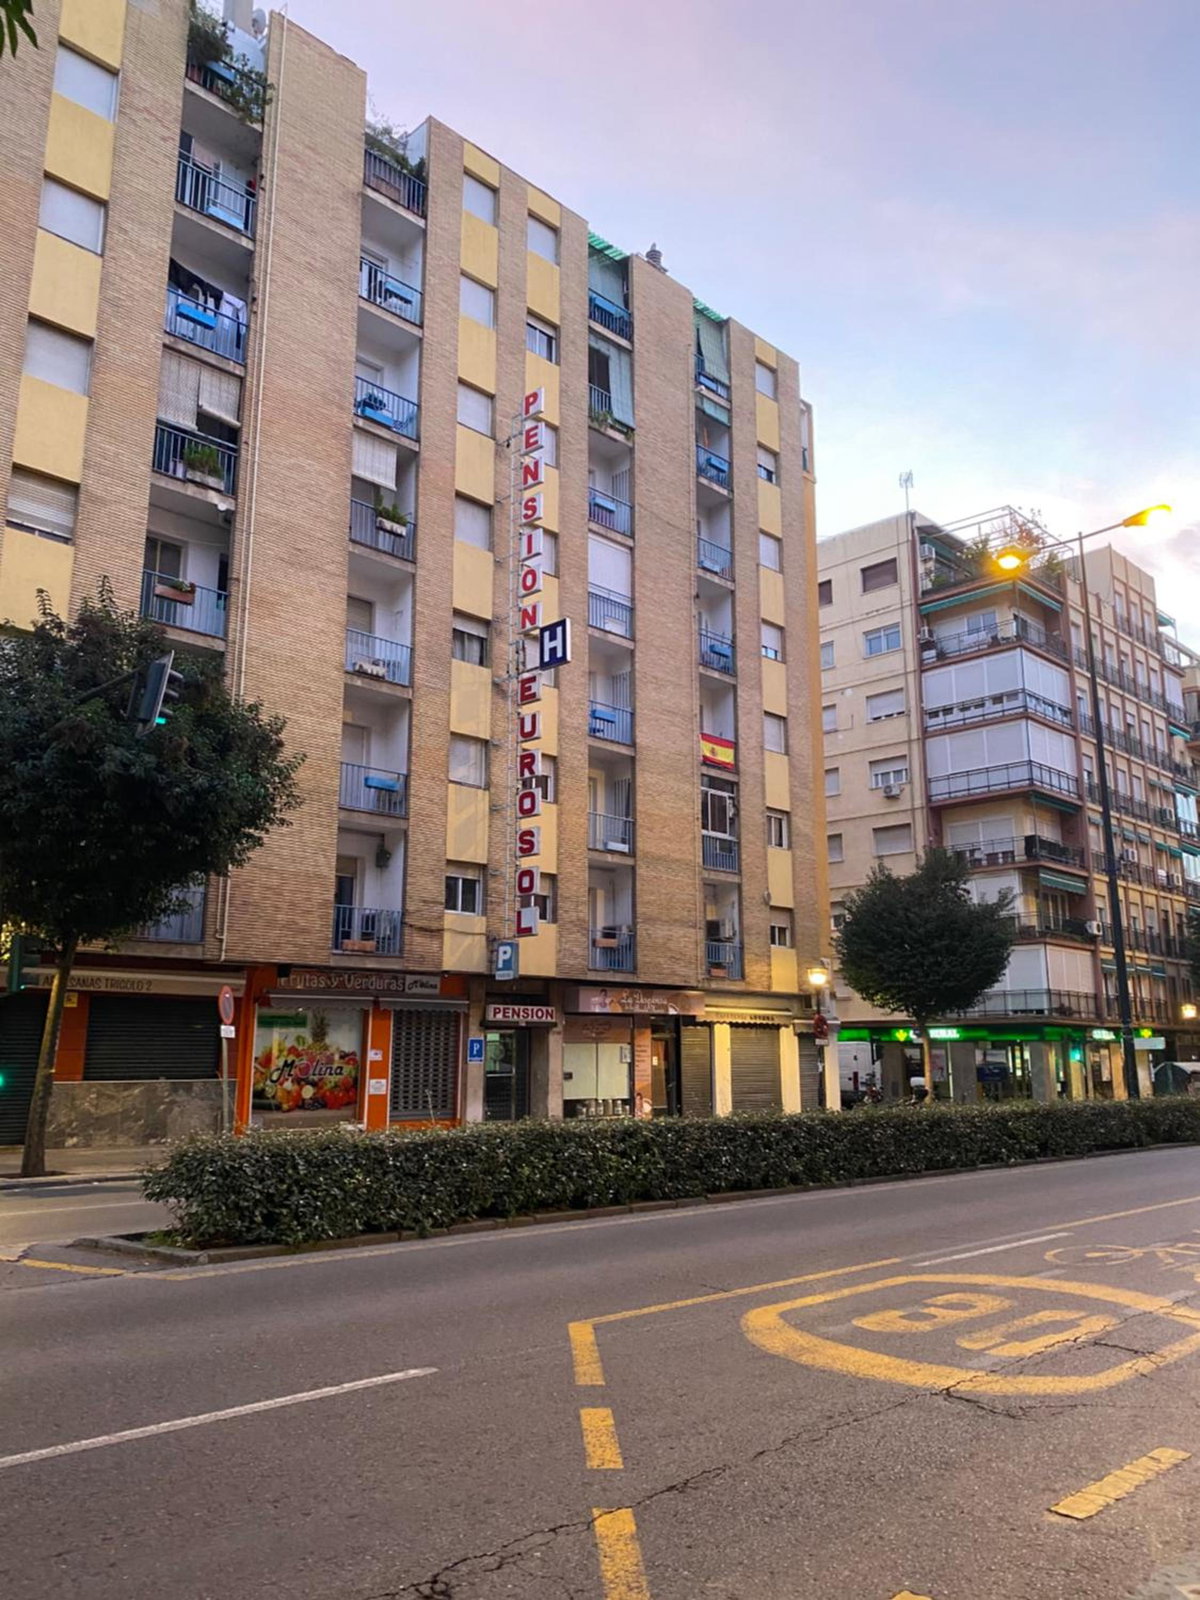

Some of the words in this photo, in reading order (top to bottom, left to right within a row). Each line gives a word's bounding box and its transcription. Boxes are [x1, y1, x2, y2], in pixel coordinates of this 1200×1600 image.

[521, 391, 539, 629] PENSION
[543, 625, 563, 662] H
[516, 675, 537, 934] EUROSOL
[497, 945, 512, 968] P
[146, 980, 153, 991] 2
[344, 973, 405, 990] Verduras
[493, 1006, 554, 1020] PENSION
[473, 1042, 480, 1055] P
[269, 1059, 345, 1084] Molina
[852, 1291, 1120, 1358] 30
